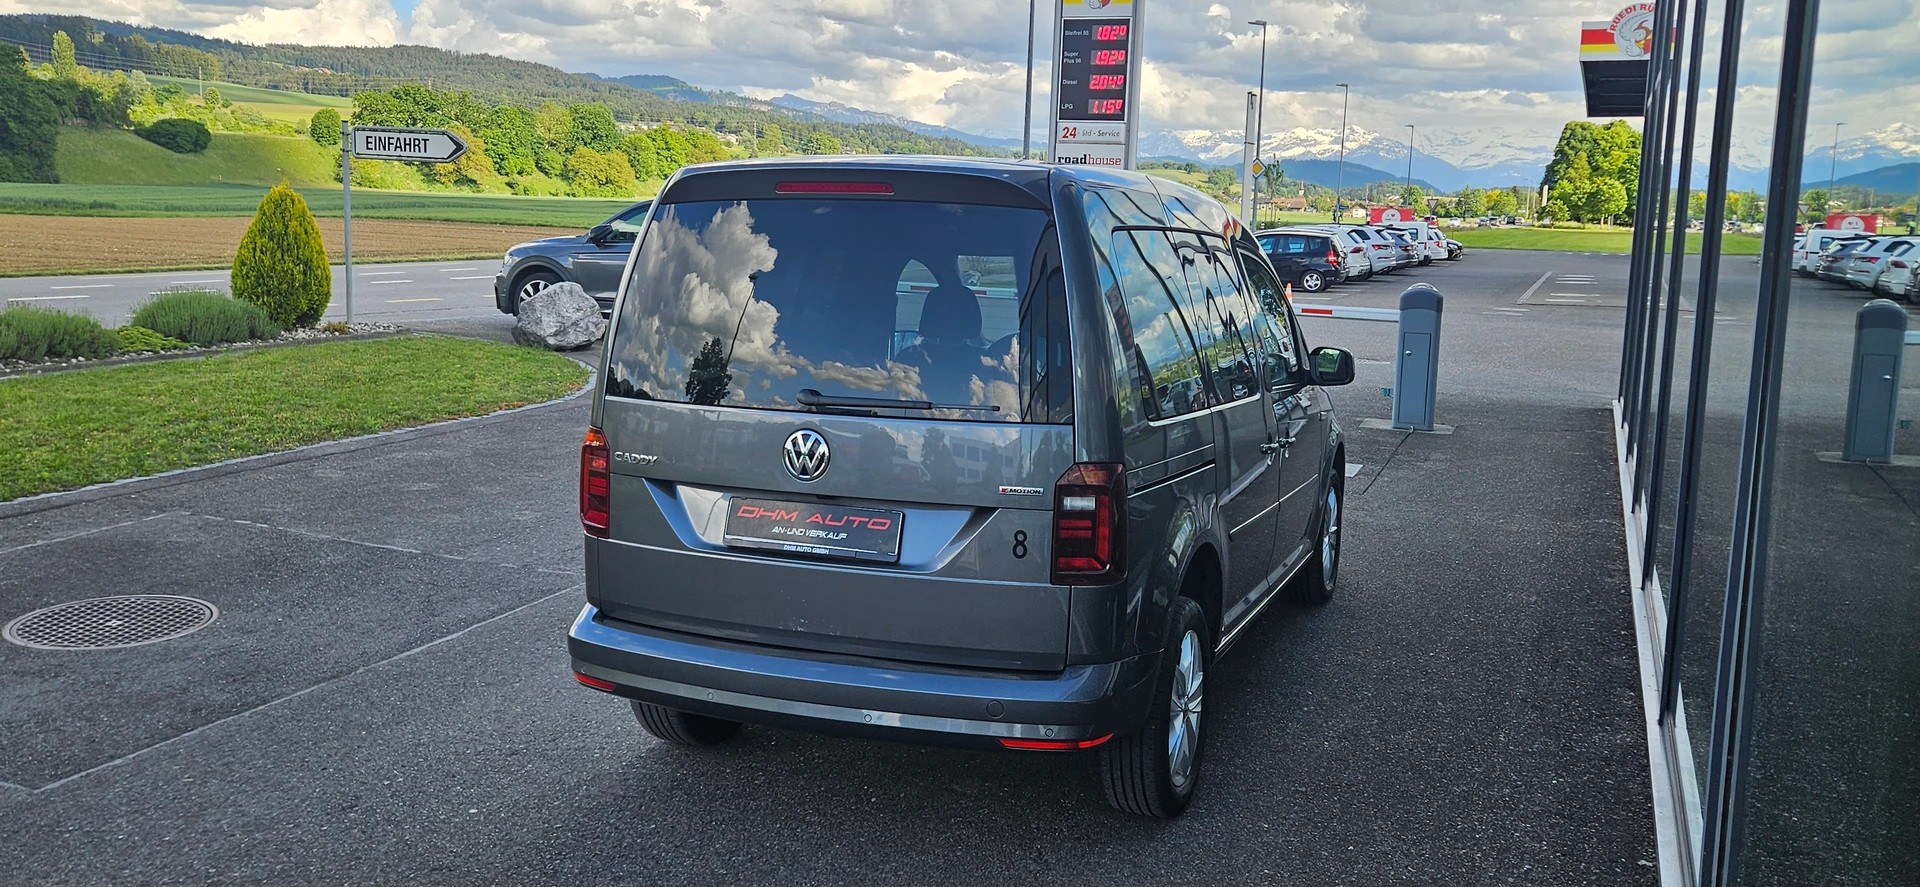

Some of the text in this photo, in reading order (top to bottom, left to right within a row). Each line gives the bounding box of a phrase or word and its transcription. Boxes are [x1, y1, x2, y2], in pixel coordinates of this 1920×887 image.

[1609, 5, 1637, 31] RUEDI
[365, 135, 430, 153] EINFAHRT
[1057, 154, 1122, 166] roadhouse
[614, 451, 659, 465] CADDY
[737, 505, 892, 531] DHM AUTO
[805, 528, 848, 540] VERKAUF
[1012, 530, 1028, 559] 8
